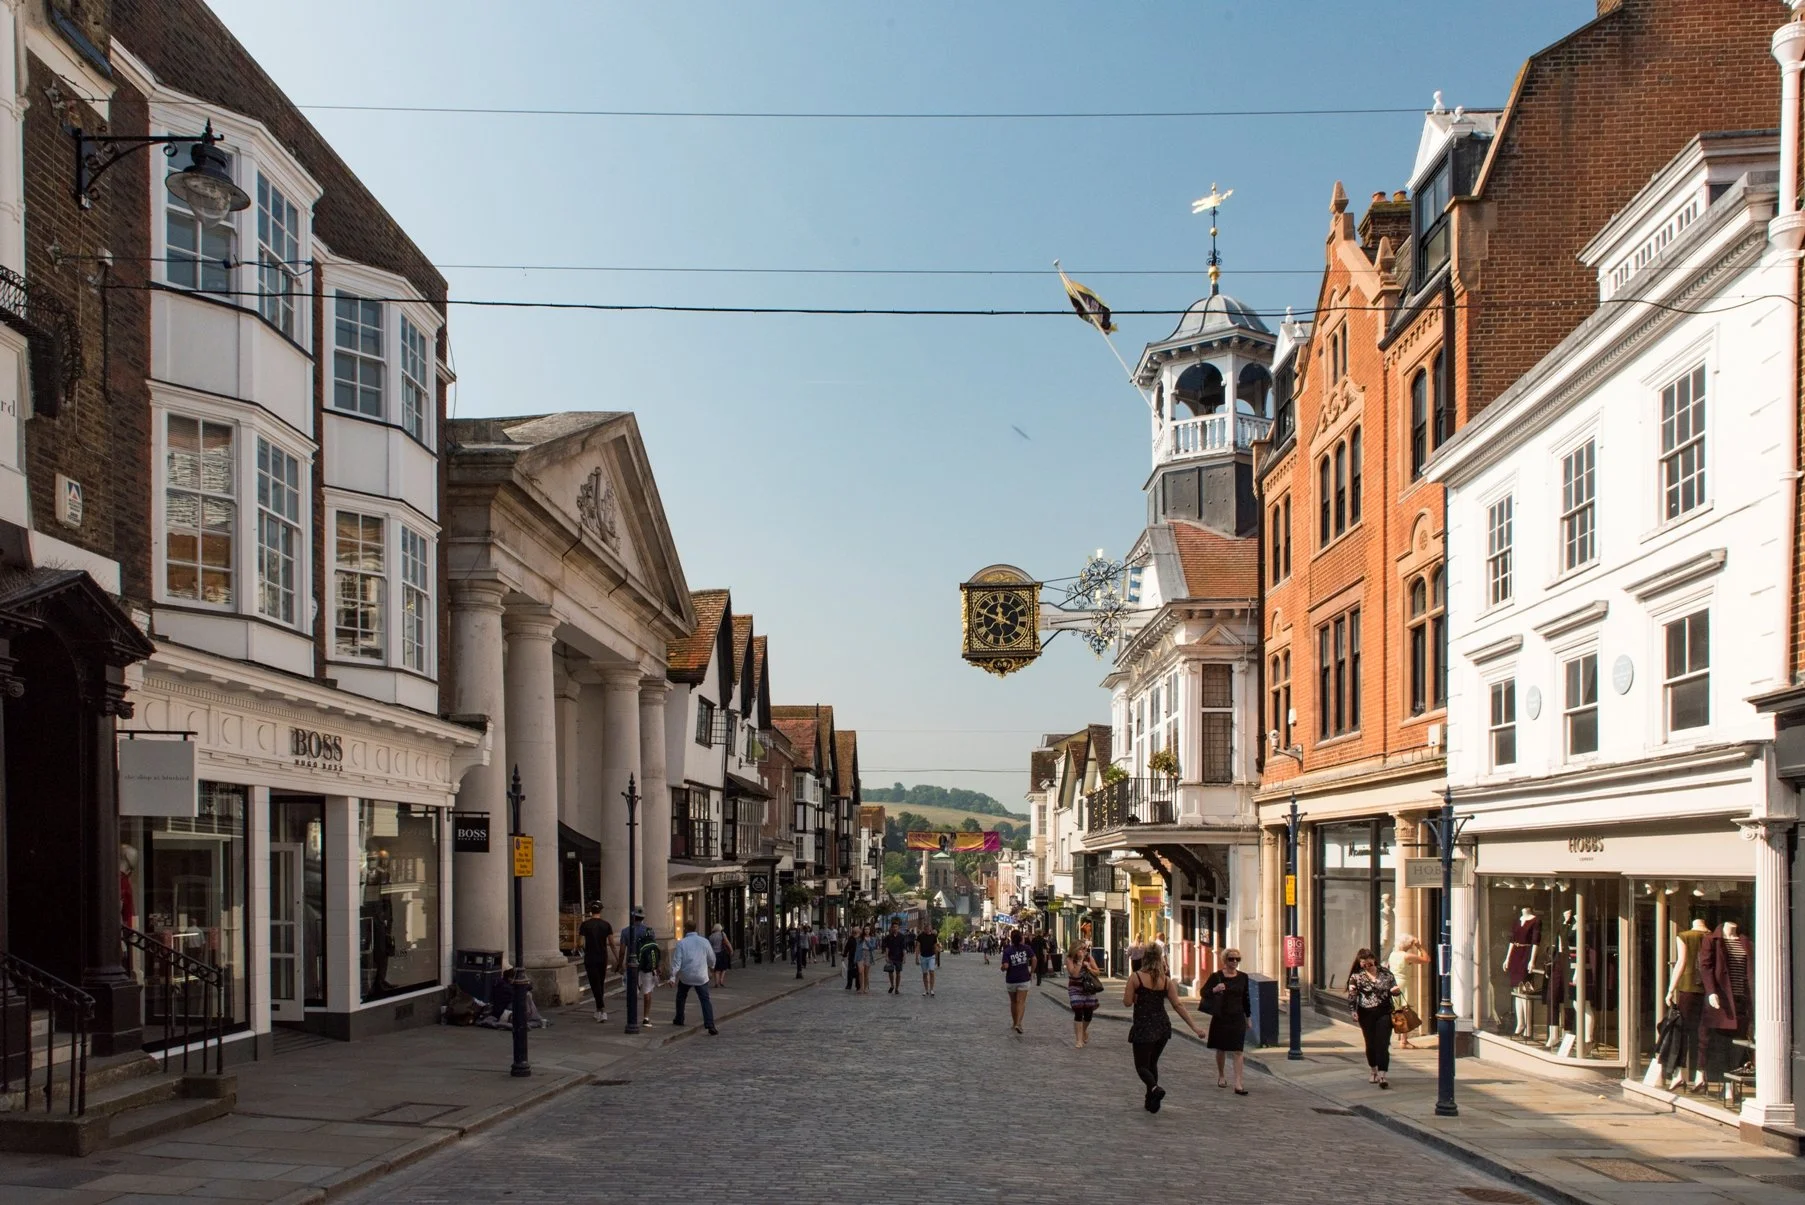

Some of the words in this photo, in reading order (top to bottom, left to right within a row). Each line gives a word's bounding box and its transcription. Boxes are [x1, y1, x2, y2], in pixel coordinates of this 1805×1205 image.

[291, 727, 343, 762] BOSS
[458, 829, 487, 838] BOSS
[1568, 835, 1605, 853] HOBBS
[1414, 865, 1458, 876] HOBS
[1287, 939, 1302, 948] BIG
[1010, 950, 1027, 960] ndcs
[1288, 951, 1302, 959] SALE
